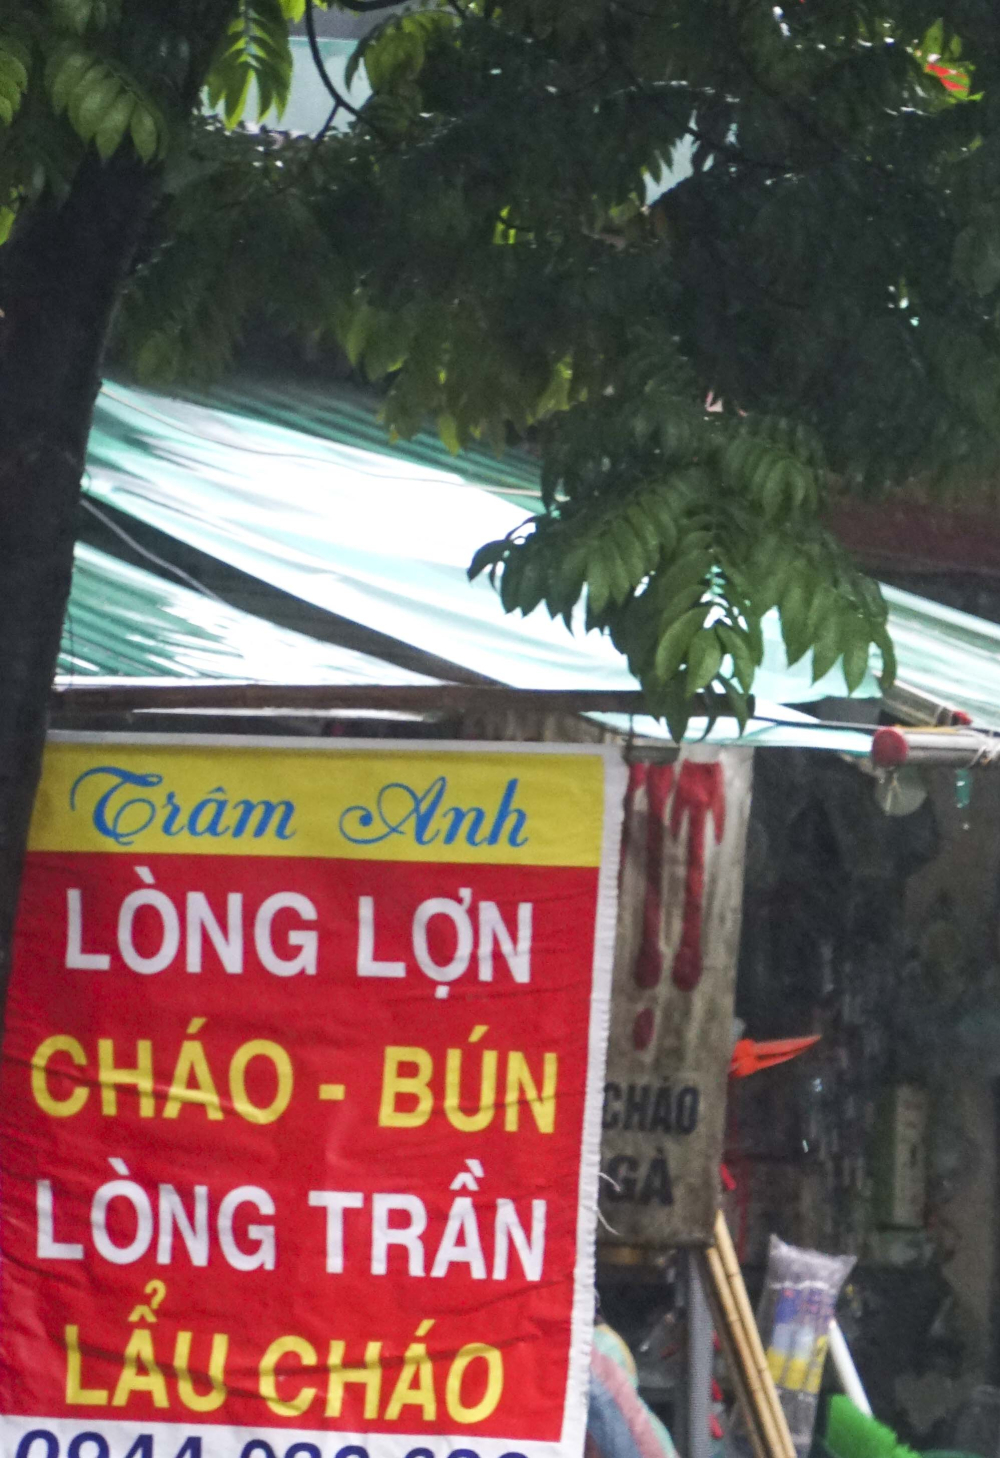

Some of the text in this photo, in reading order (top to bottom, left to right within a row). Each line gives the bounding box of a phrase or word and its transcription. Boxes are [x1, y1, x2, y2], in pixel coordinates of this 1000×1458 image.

[70, 766, 528, 848] Trâm Anh
[65, 866, 533, 999] LÒNG LỢN
[30, 1017, 558, 1134] CHÁO - BÚN
[36, 1157, 547, 1282] LÒNG TRẦN
[65, 1279, 503, 1424] LẨU CHÁO
